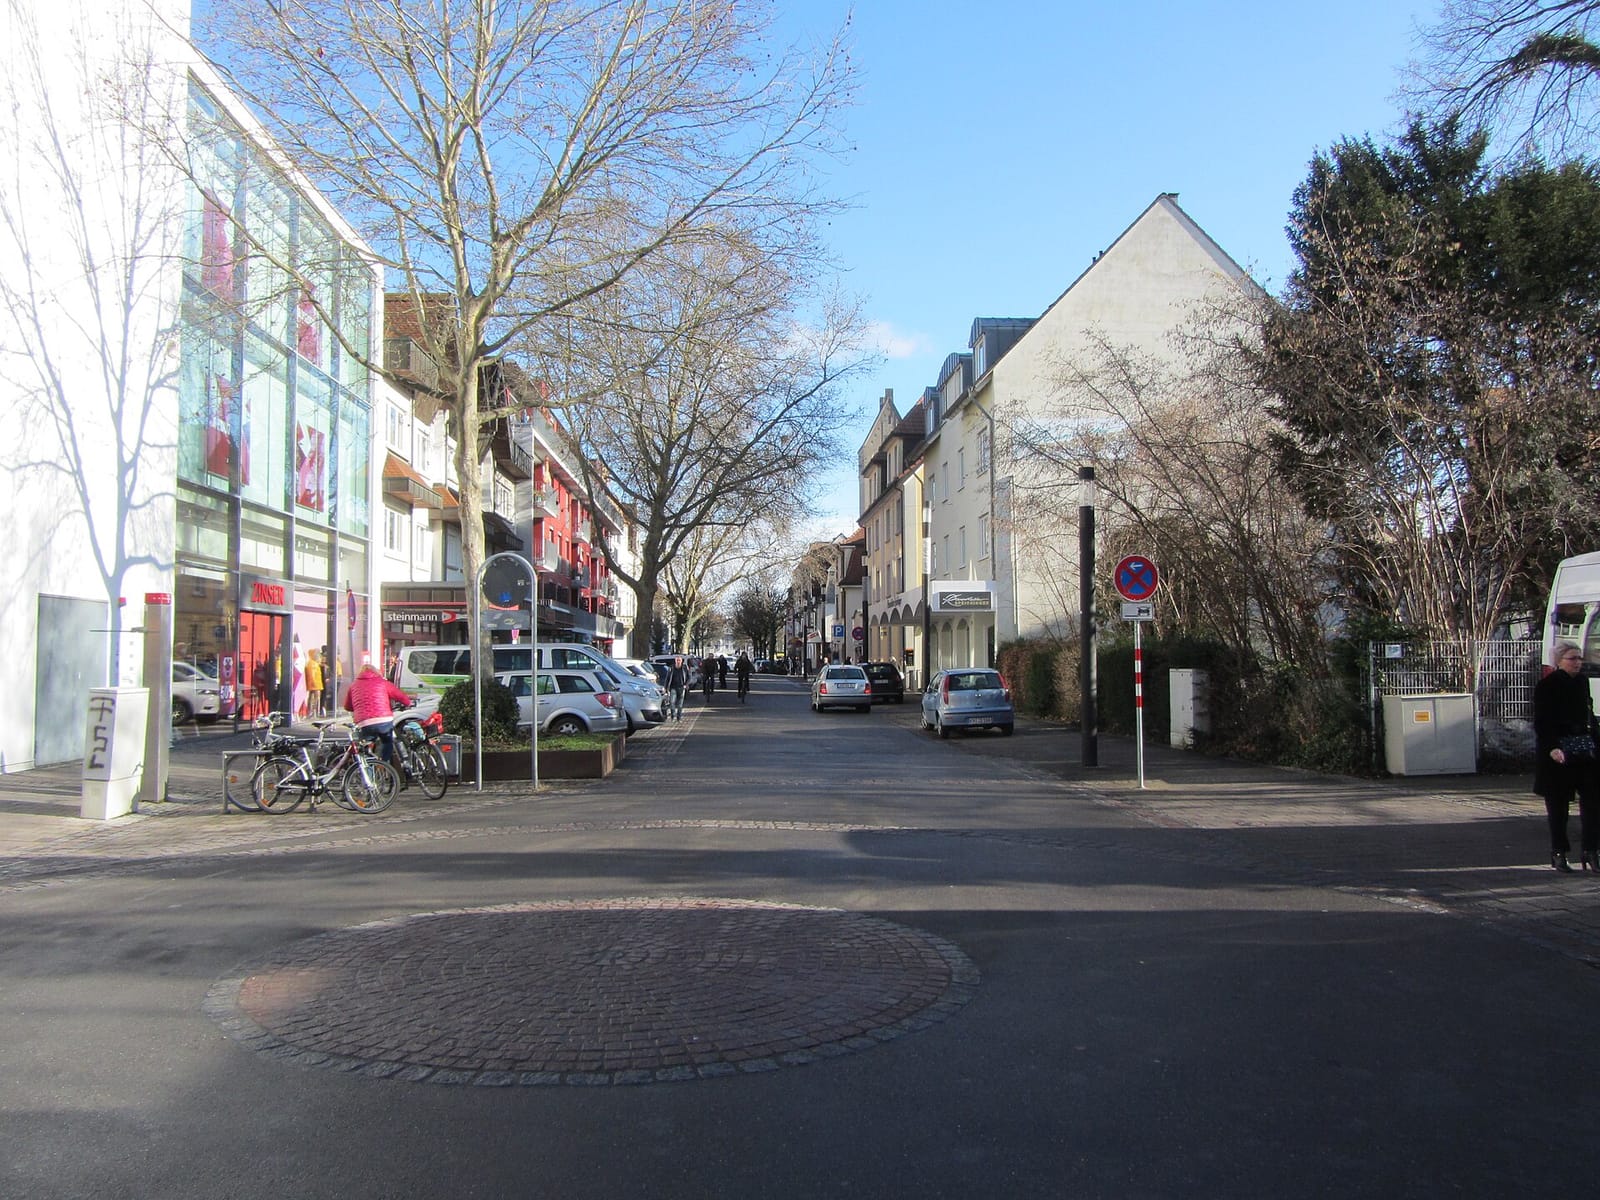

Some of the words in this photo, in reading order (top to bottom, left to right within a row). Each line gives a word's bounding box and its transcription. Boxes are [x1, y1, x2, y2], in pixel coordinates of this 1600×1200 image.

[251, 582, 285, 606] ZINSER
[388, 612, 438, 621] steinmann
[835, 626, 842, 636] P
